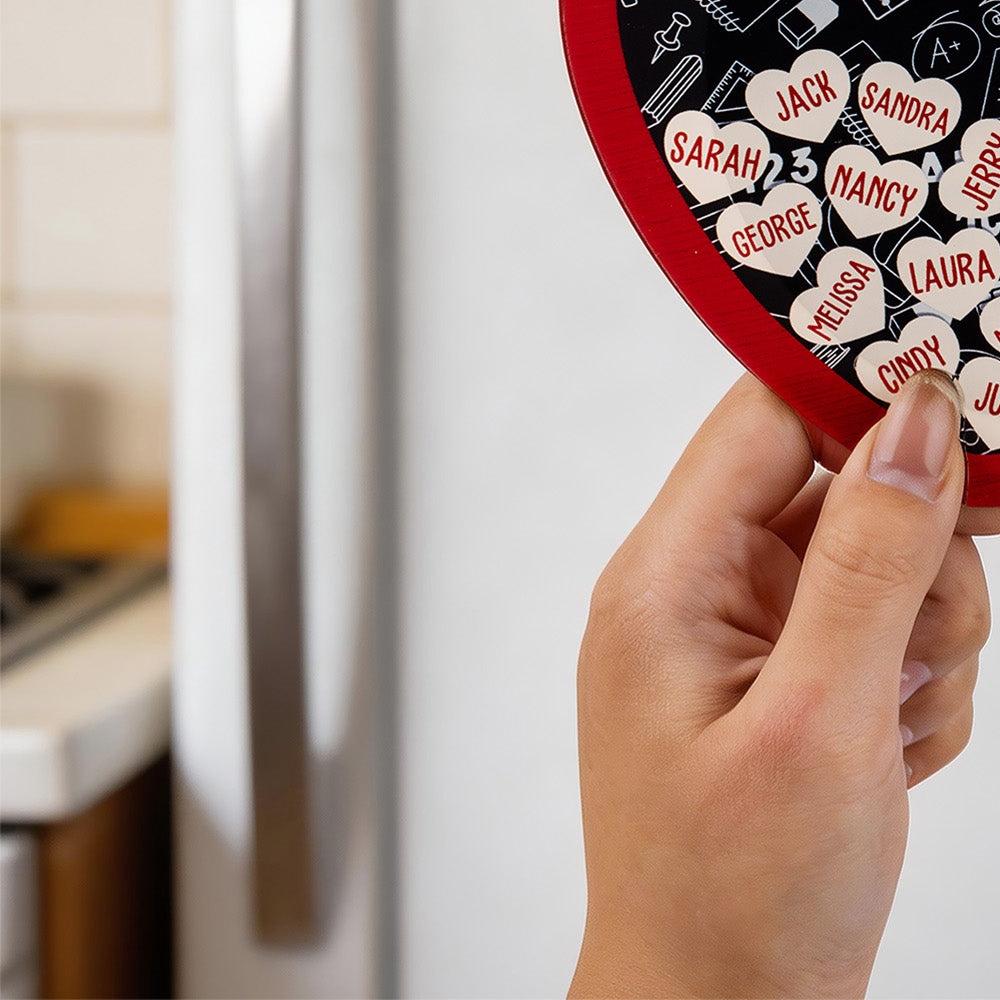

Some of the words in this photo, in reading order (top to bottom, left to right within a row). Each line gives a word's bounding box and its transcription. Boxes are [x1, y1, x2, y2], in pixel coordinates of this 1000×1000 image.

[930, 36, 961, 69] A+
[776, 70, 838, 122] JACK
[861, 81, 949, 137] SANDRA
[669, 131, 762, 181] SARAH
[829, 164, 918, 217] NANCY
[731, 201, 817, 258] GEORGE
[909, 249, 996, 295] LAURA
[807, 260, 876, 342] MELISSA
[877, 334, 947, 395] CINDY
